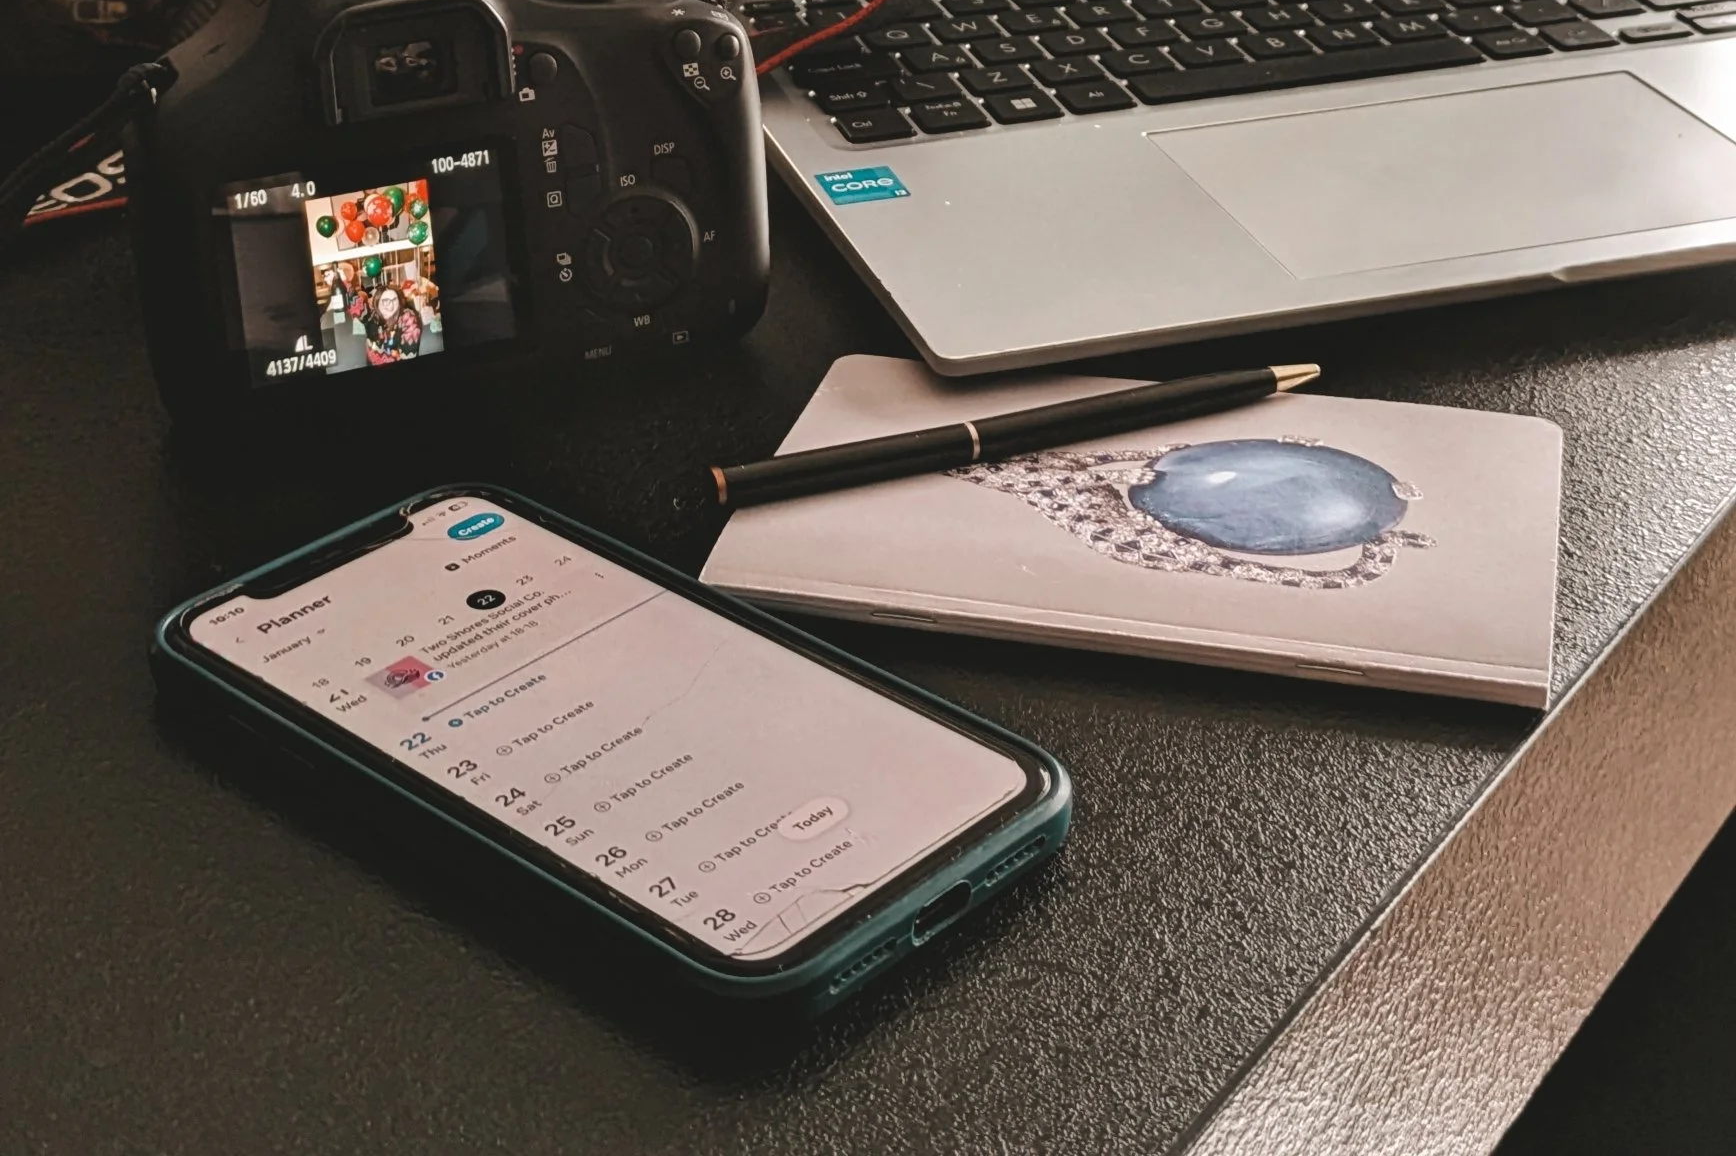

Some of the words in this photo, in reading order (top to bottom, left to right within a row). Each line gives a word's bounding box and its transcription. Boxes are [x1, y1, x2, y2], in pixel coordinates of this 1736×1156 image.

[951, 21, 977, 32] W
[1128, 54, 1150, 65] C
[542, 128, 556, 138] Av
[851, 120, 873, 128] Ctrl
[653, 142, 676, 155] DISP
[431, 149, 490, 175] 100-4871
[620, 174, 636, 187] ISO
[823, 172, 853, 182] intel
[233, 188, 268, 210] 1/60
[291, 180, 316, 199] 4.0
[703, 230, 716, 242] AF
[633, 314, 651, 327] WB
[266, 349, 337, 377] 4137/4409
[584, 345, 613, 360] MENU
[457, 516, 495, 536] Create
[461, 535, 517, 564] Moments
[209, 606, 245, 626] 10:10
[256, 594, 333, 634] Planner
[312, 677, 330, 689] 18
[355, 656, 372, 667] 19
[396, 634, 415, 647] 20
[438, 614, 455, 625] 21
[476, 594, 496, 606] 22
[516, 574, 534, 585] 23
[554, 555, 572, 566] 24
[420, 639, 447, 655] Two
[446, 617, 490, 641] Shores
[488, 598, 524, 620] Social
[523, 589, 545, 601] Co.
[433, 631, 484, 663] updated
[482, 619, 511, 638] their
[511, 602, 544, 621] cover
[262, 636, 312, 664] January
[447, 641, 500, 669] Yesterday
[499, 634, 510, 644] at
[336, 694, 367, 713] Wed
[463, 704, 491, 721] Tap
[490, 695, 505, 708] to
[504, 672, 548, 699] Create
[512, 732, 539, 748] Tap
[537, 722, 554, 735] to
[552, 700, 595, 726] Create
[399, 731, 433, 751] 22
[559, 759, 587, 776] Tap
[586, 750, 602, 763] to
[600, 726, 644, 753] Create
[418, 743, 448, 762] Thu
[447, 759, 479, 779] 23
[470, 772, 492, 786] Fri
[609, 787, 637, 804] Tap
[636, 778, 652, 791] to
[650, 753, 694, 781] Create
[495, 787, 527, 808] 24
[515, 799, 543, 817] Sat
[661, 815, 689, 833] Tap
[687, 805, 703, 819] to
[702, 781, 745, 809] Create
[544, 815, 577, 837] 25
[792, 805, 834, 832] Today
[565, 828, 595, 847] Sun
[714, 845, 742, 863] Tap
[740, 835, 757, 848] to
[755, 811, 792, 838] Cre
[594, 845, 628, 867] 26
[768, 875, 797, 894] Tap
[796, 865, 812, 879] to
[809, 839, 853, 869] Create
[615, 856, 649, 879] Mon
[648, 876, 677, 899] 27
[670, 889, 699, 908] Tue
[702, 908, 737, 931] 28
[723, 919, 758, 944] Wed
